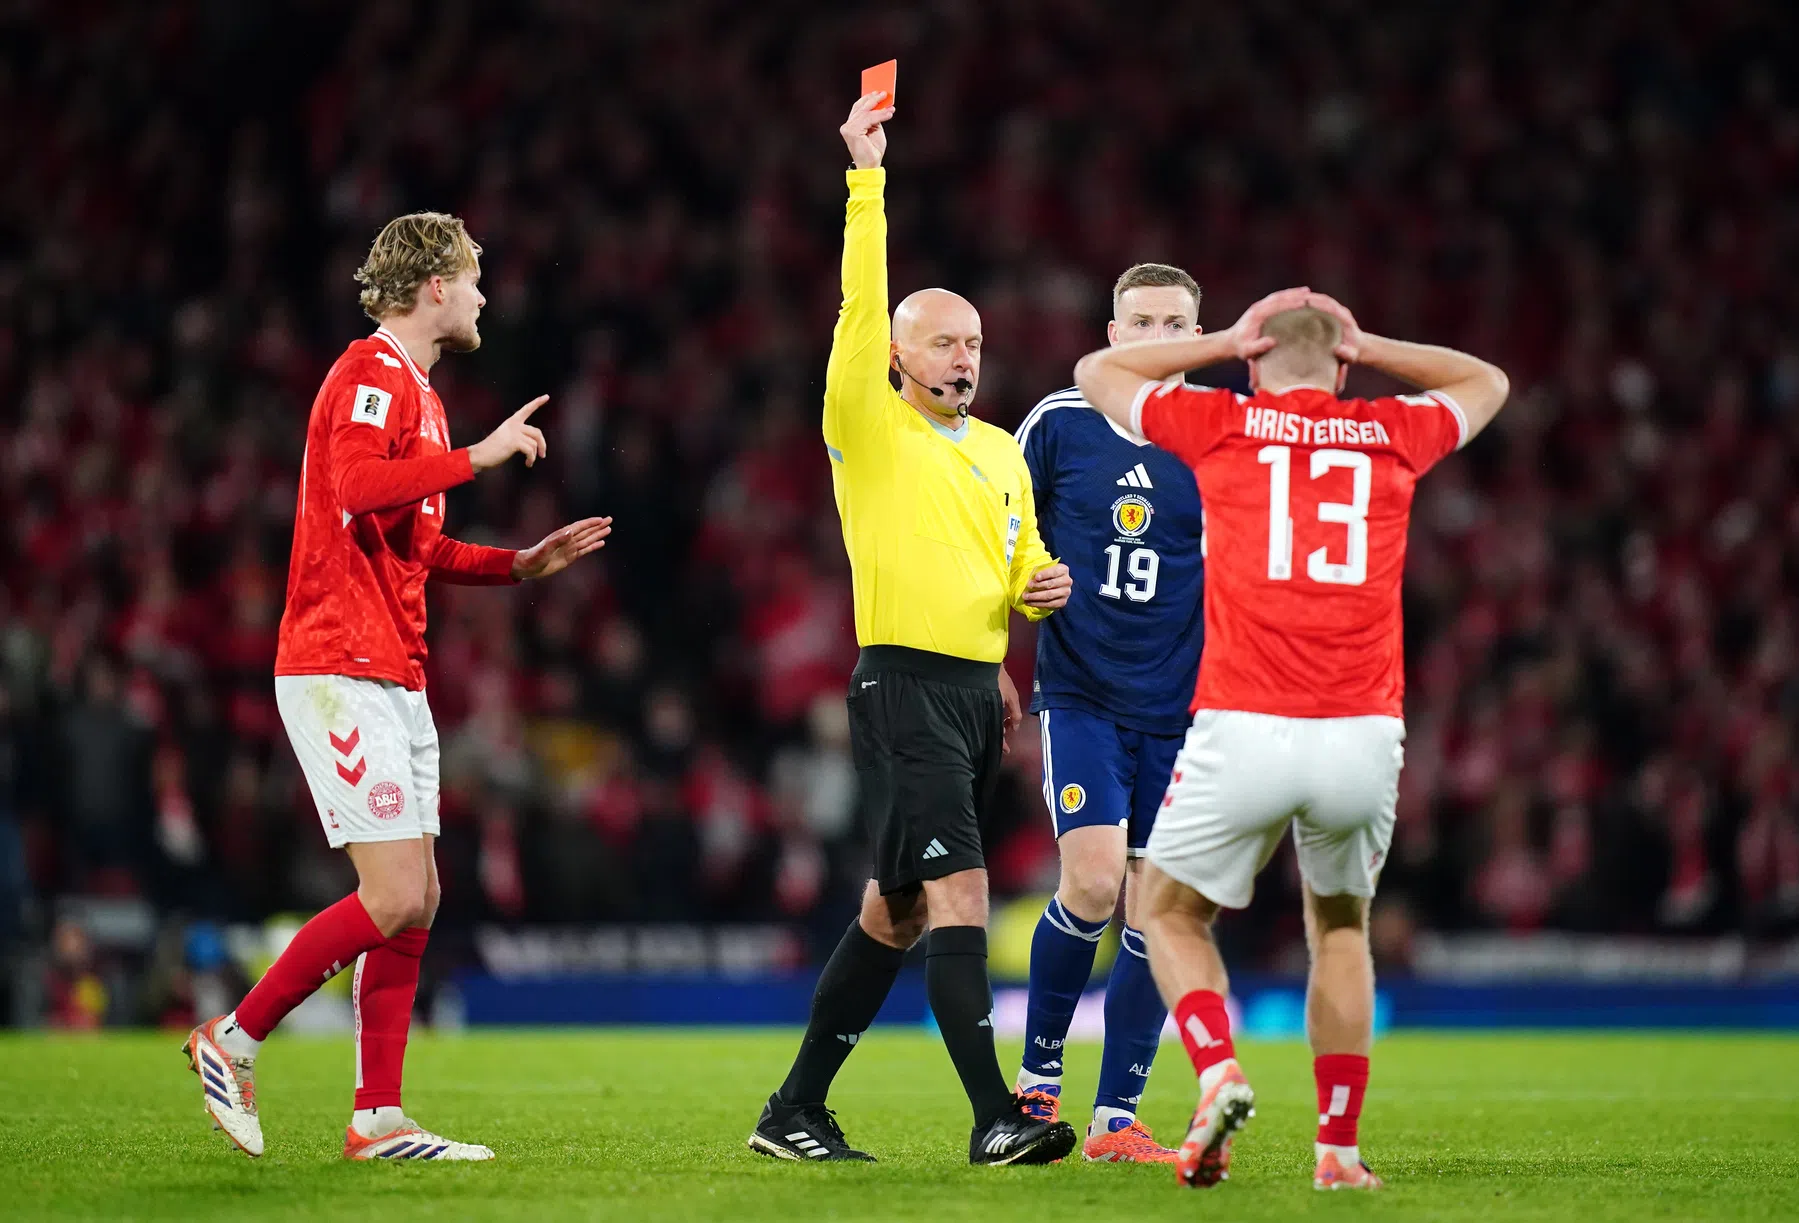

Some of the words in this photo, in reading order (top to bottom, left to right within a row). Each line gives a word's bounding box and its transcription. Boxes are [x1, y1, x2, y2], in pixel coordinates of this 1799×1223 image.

[1244, 406, 1390, 445] KRISTENSEN
[1010, 518, 1021, 531] FIF
[1257, 445, 1372, 586] 13
[1099, 544, 1159, 602] 19
[375, 793, 398, 807] DBU
